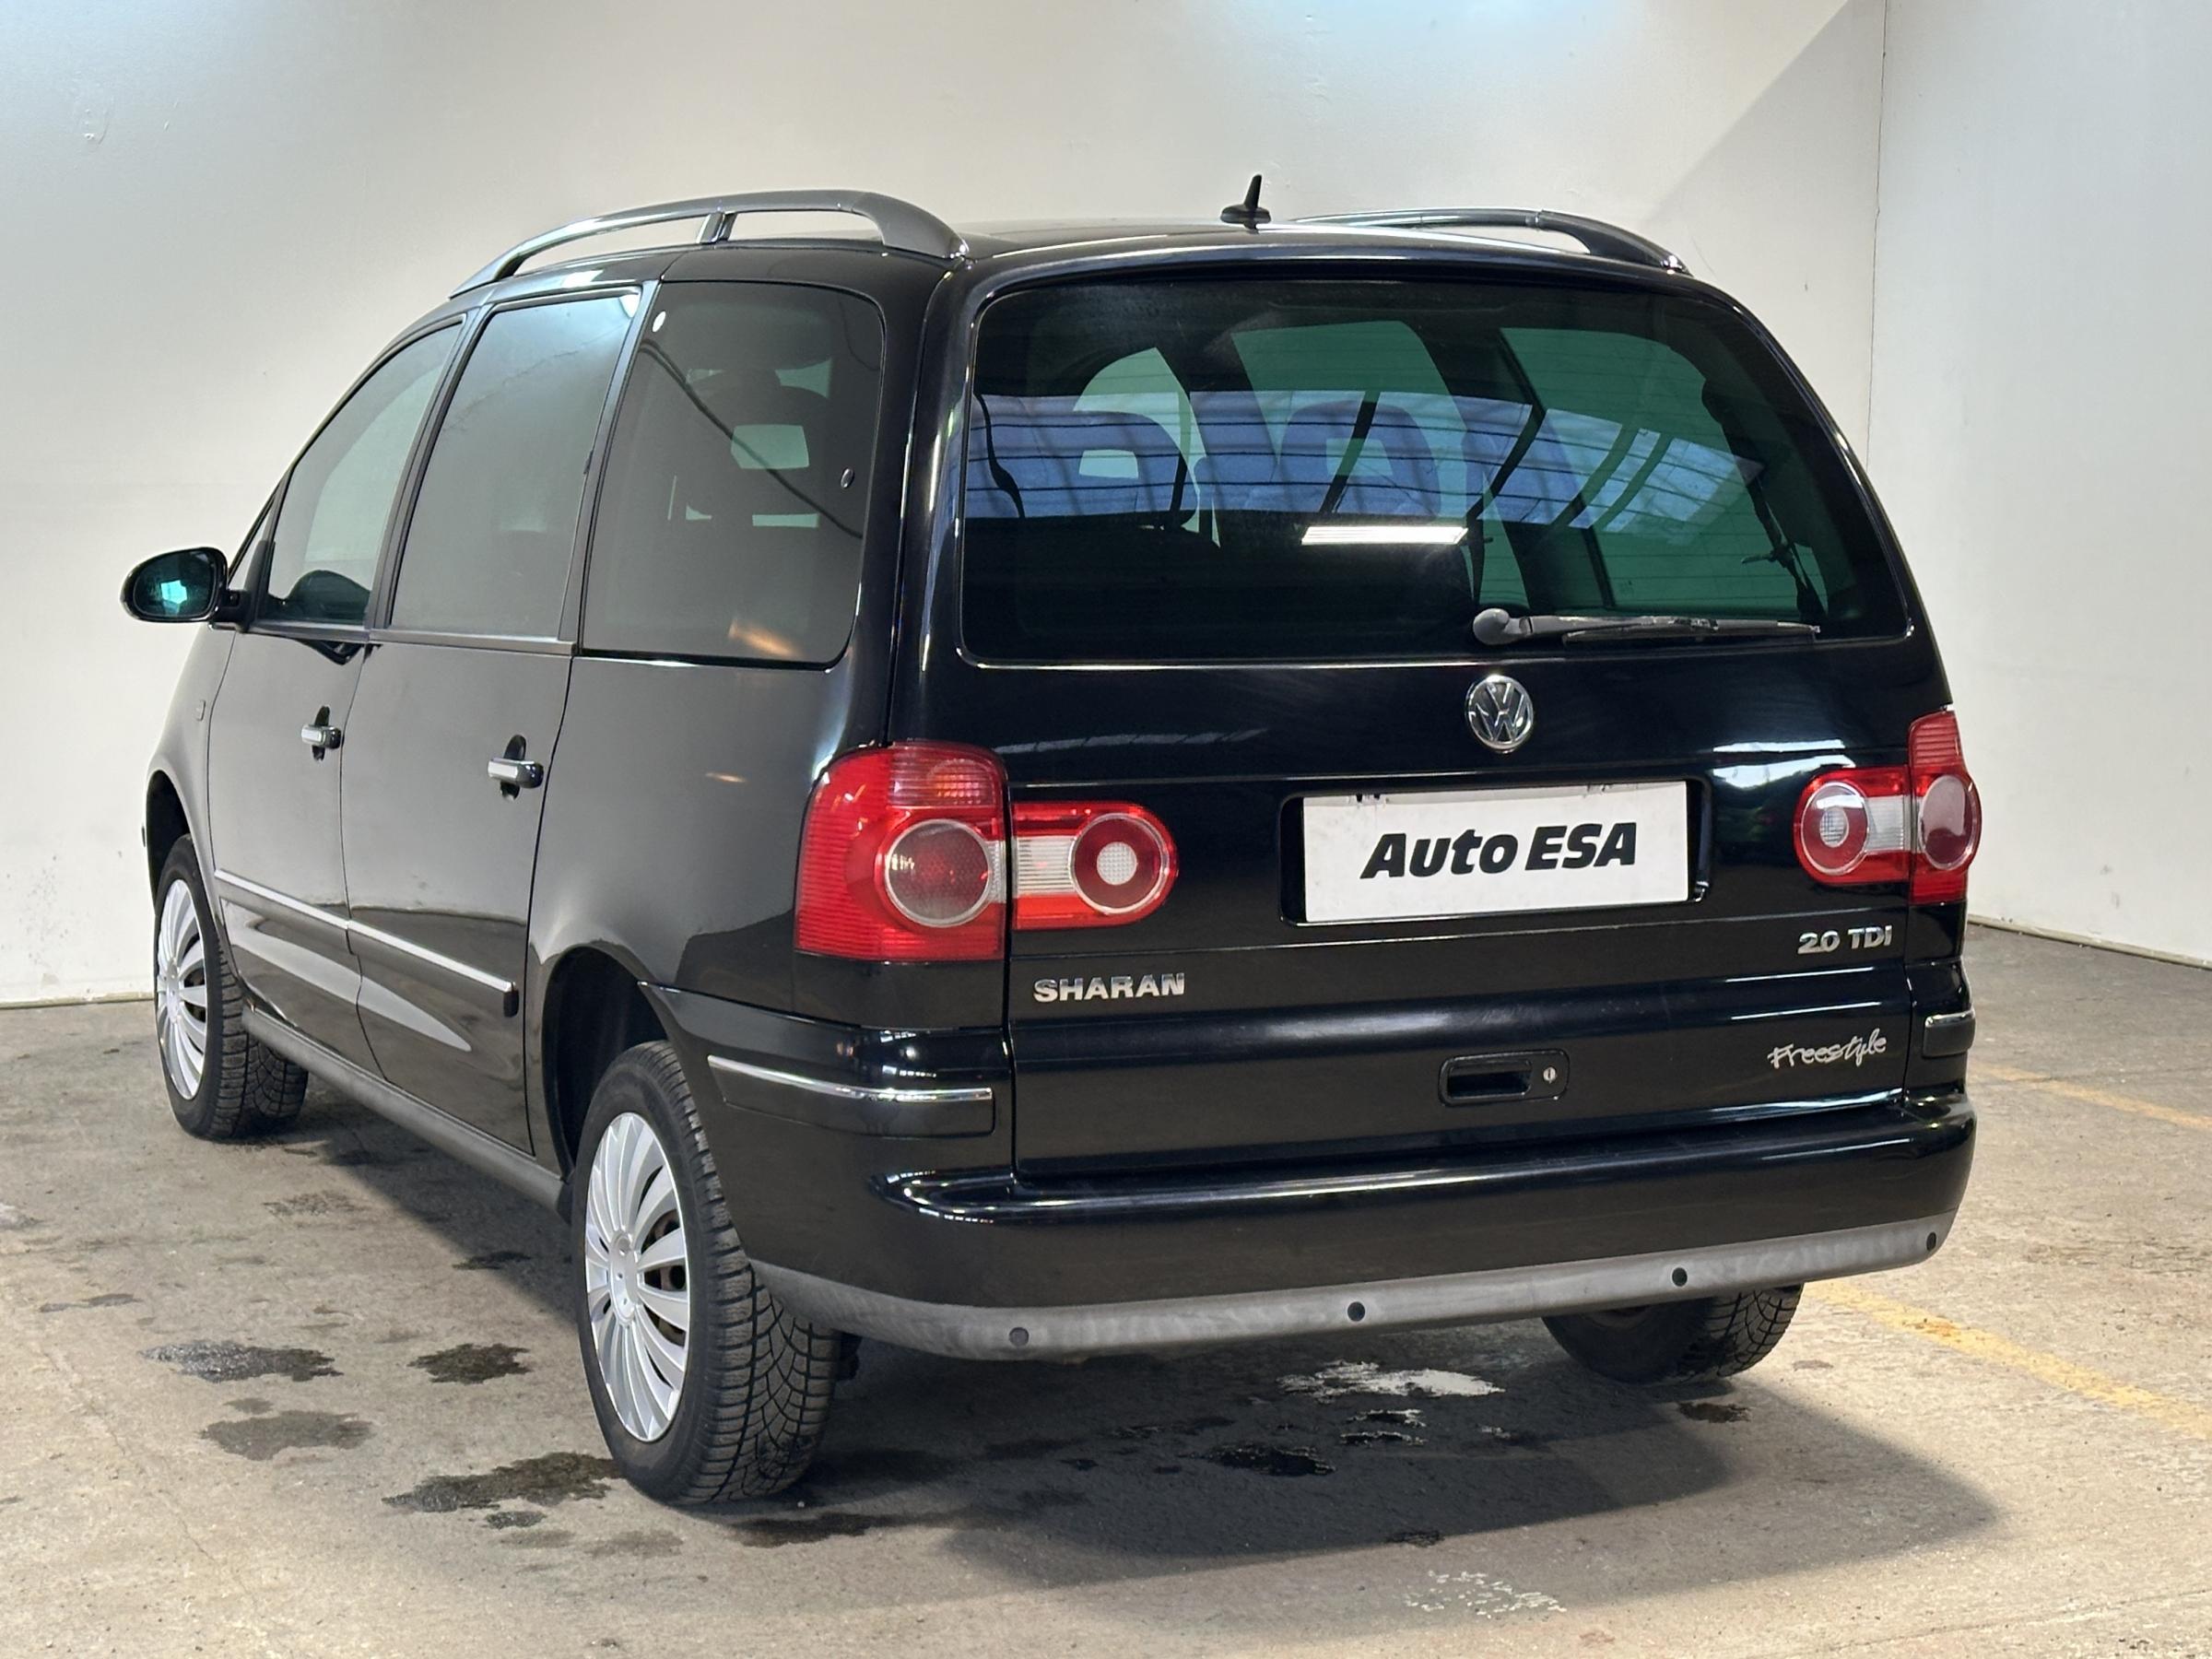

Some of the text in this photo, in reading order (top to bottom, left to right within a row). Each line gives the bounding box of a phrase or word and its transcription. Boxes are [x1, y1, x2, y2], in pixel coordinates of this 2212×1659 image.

[1359, 822, 1637, 879] Auto ESA
[1033, 972, 1185, 1003] SHARAN
[1767, 1028, 1887, 1069] Freestyle
